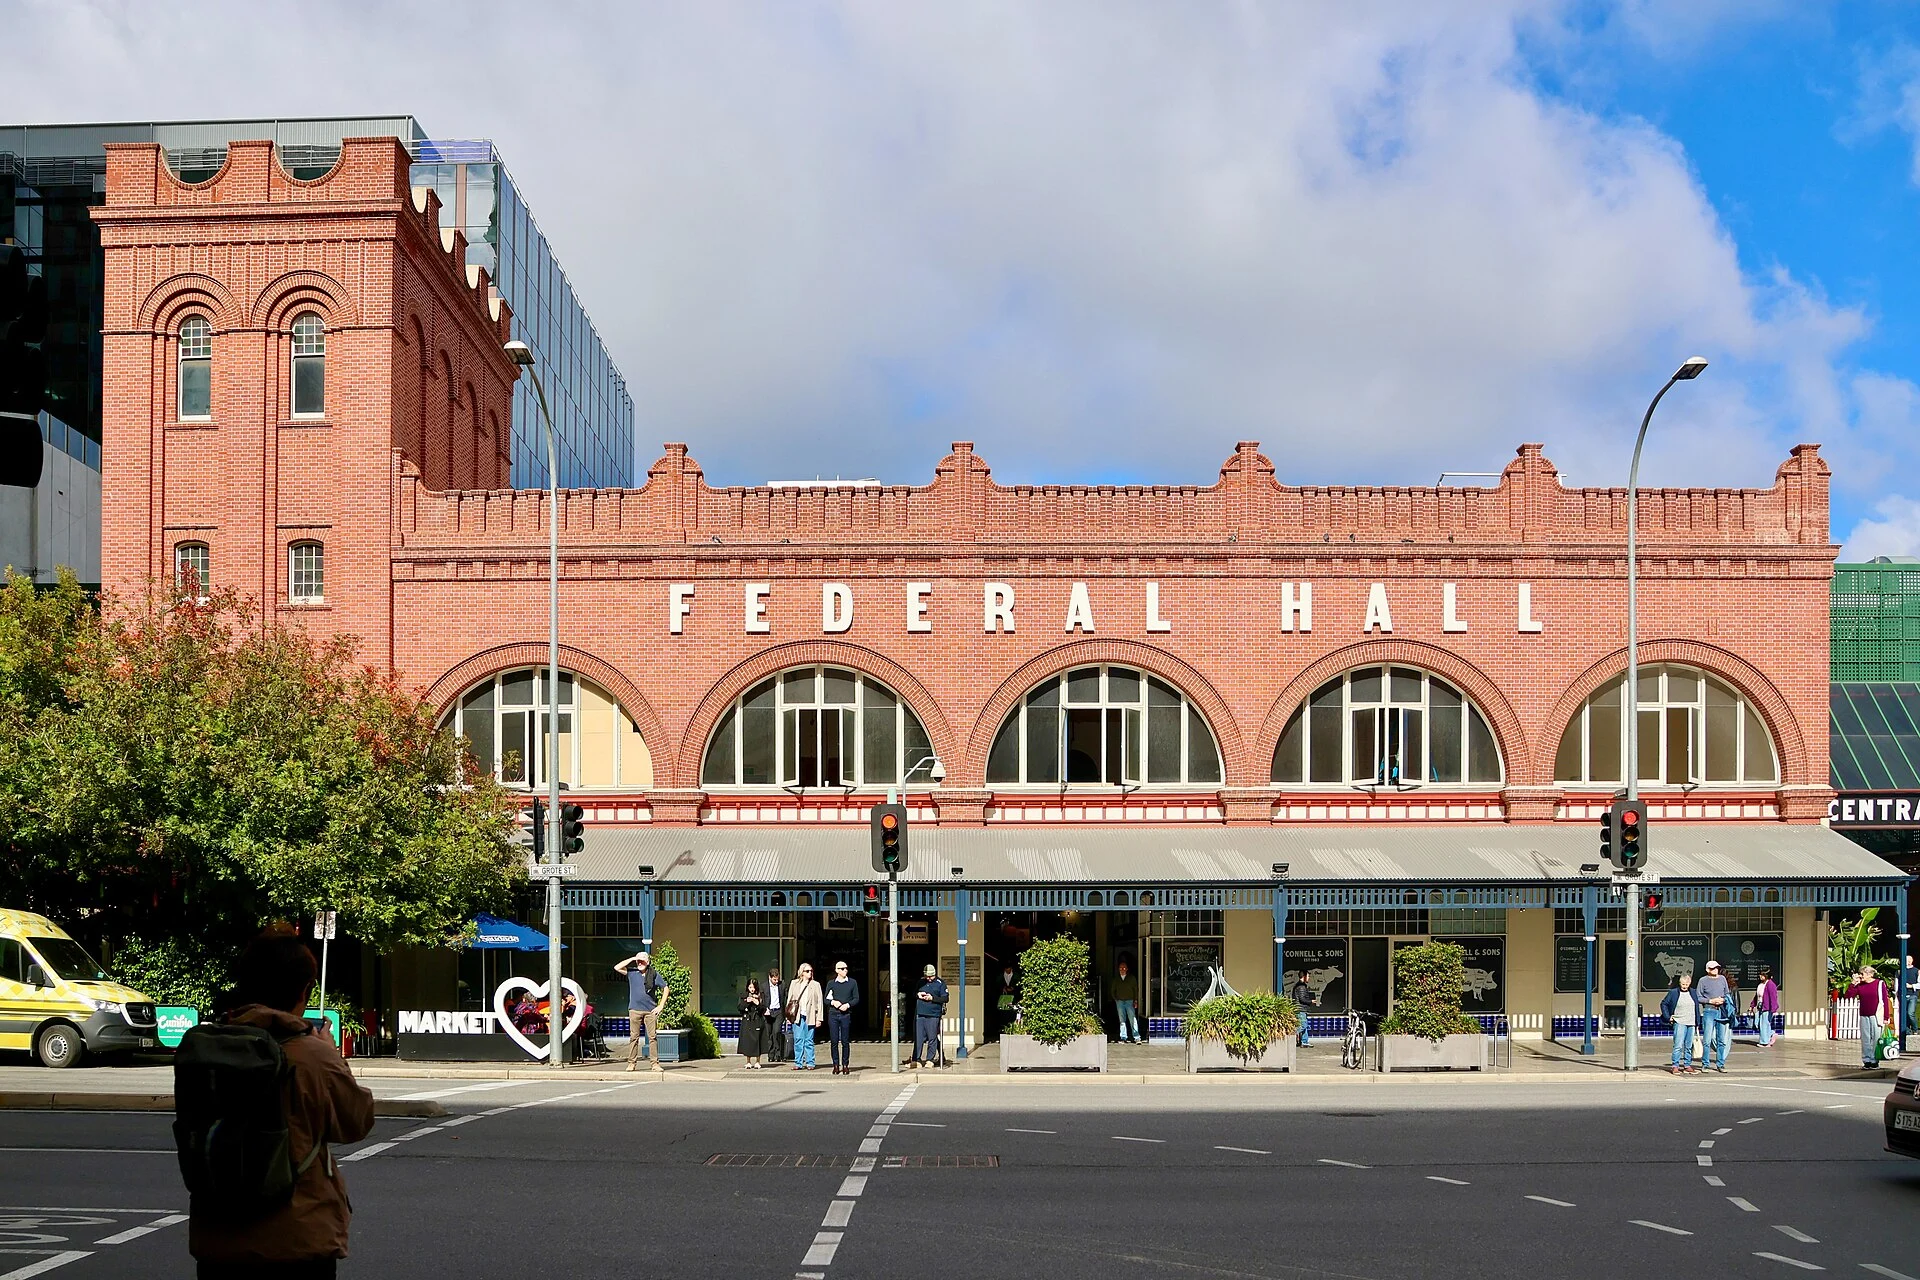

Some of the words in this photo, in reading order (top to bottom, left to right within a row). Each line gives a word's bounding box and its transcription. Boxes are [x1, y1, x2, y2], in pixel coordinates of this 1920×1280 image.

[669, 582, 1171, 632] FEDERAL
[1280, 581, 1543, 632] HALL
[1624, 873, 1646, 881] GROTE
[1283, 950, 1315, 958] 'CONNELL
[1325, 949, 1344, 957] SONS
[1482, 948, 1501, 956] SONS
[398, 1010, 498, 1034] MARKET
